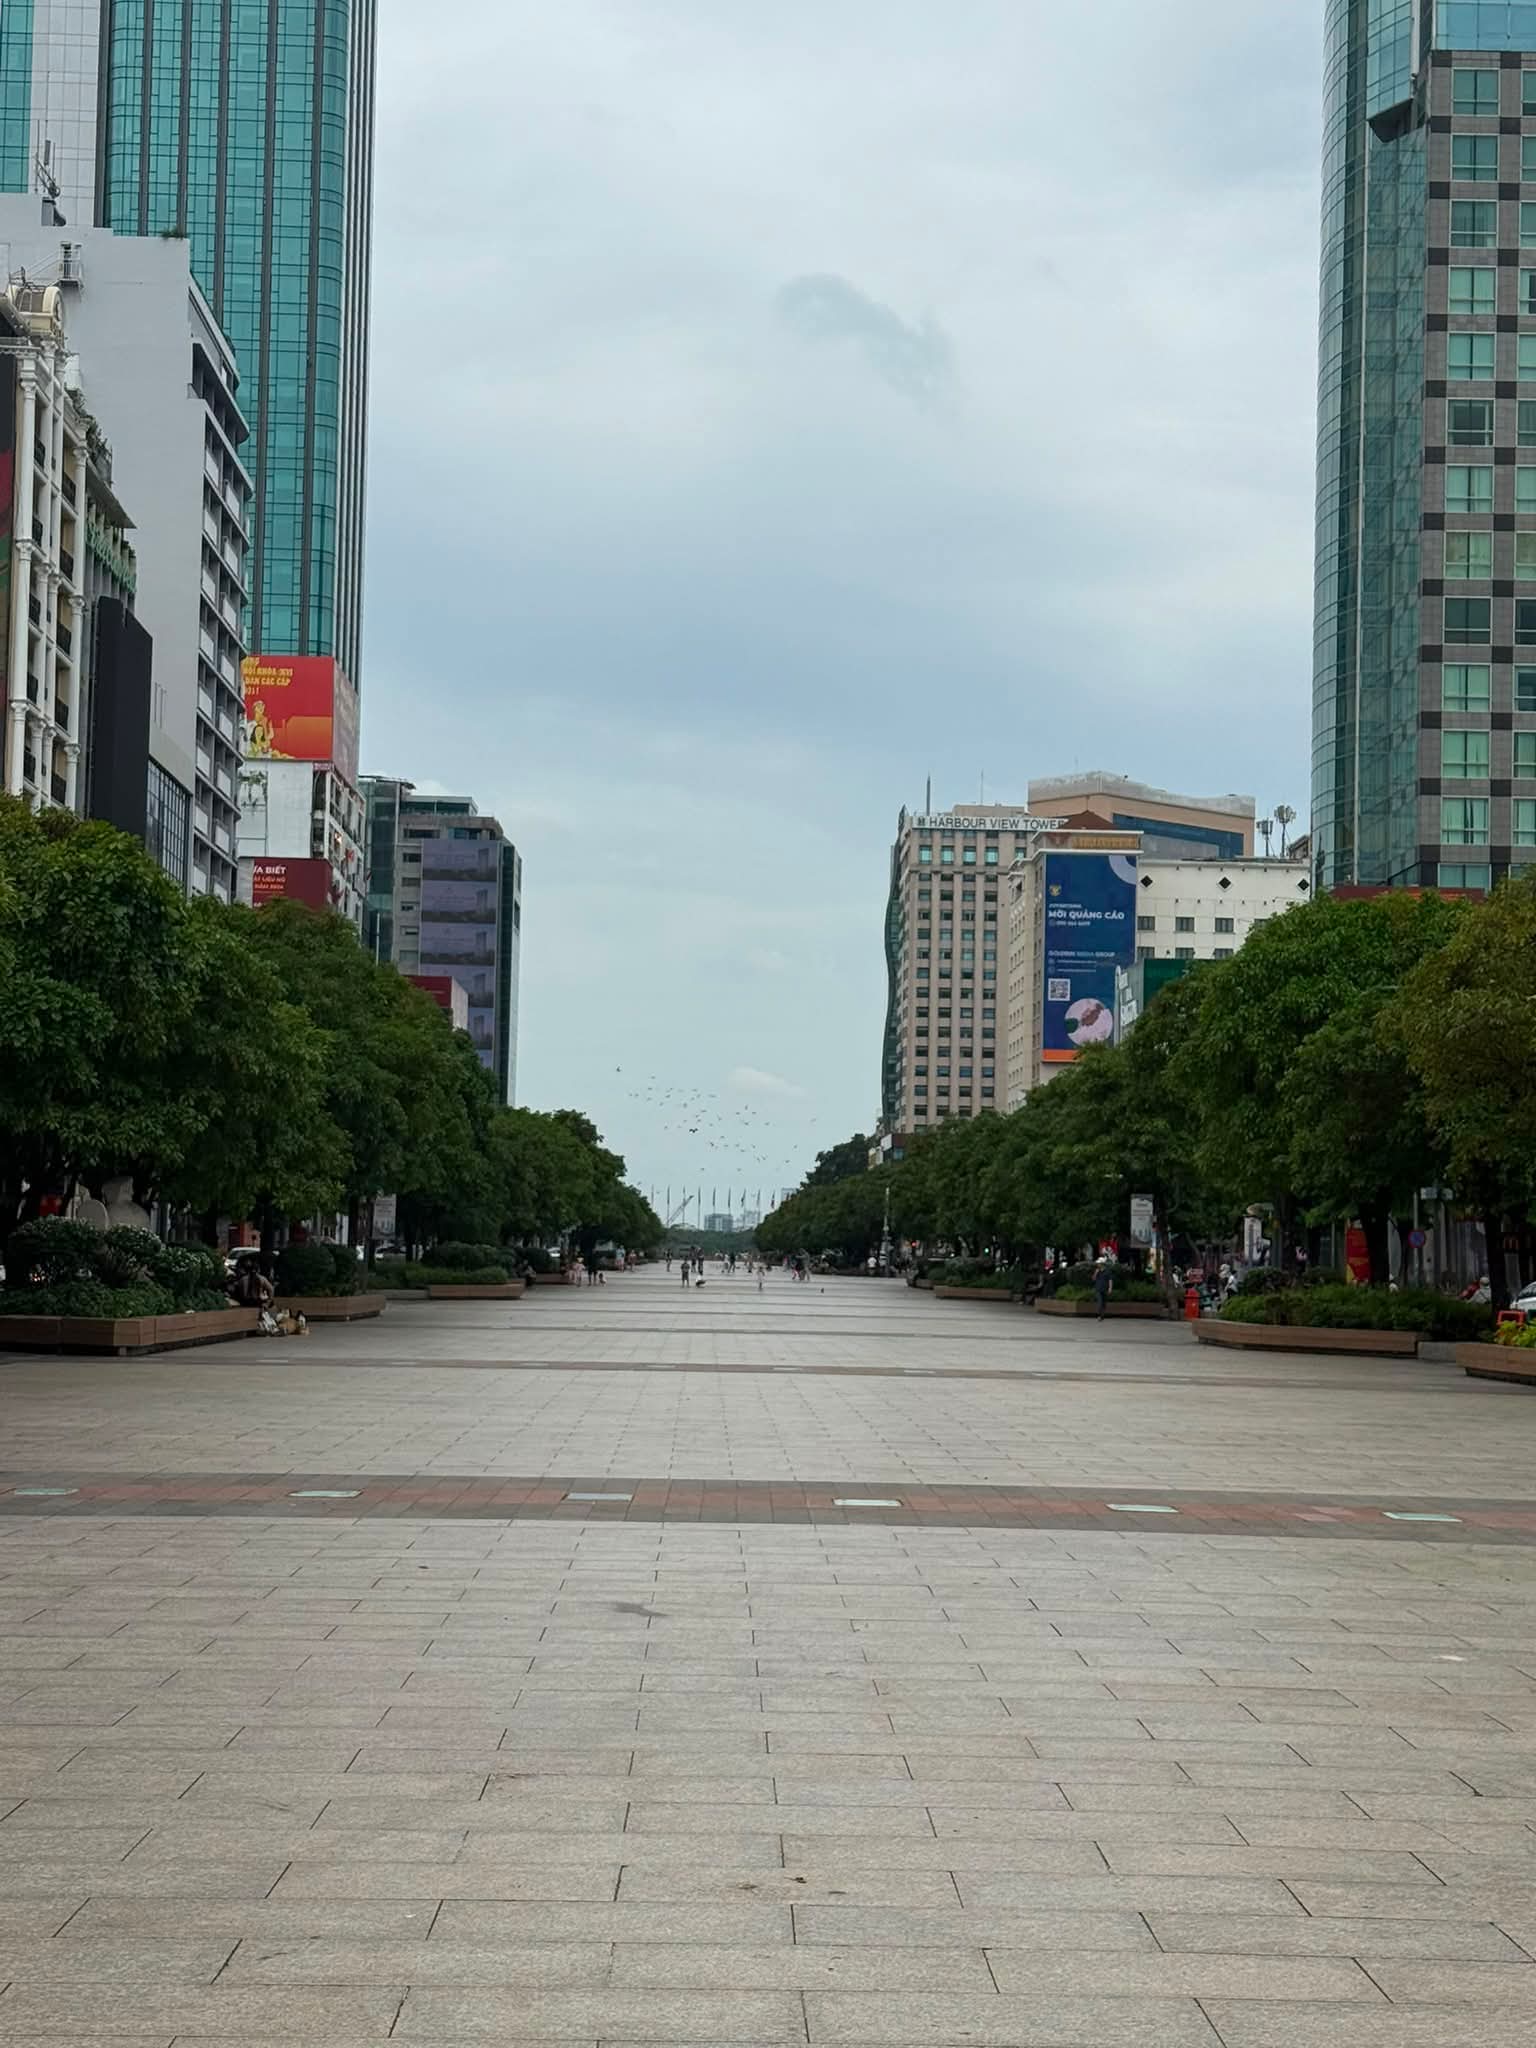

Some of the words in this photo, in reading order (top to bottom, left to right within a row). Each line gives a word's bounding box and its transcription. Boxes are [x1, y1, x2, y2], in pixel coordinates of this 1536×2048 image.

[929, 817, 986, 828] HARBOUR
[989, 818, 1020, 829] VIEW
[1048, 909, 1067, 919] MỜI
[1069, 908, 1103, 920] QUẢNG
[1104, 909, 1125, 920] CÁO
